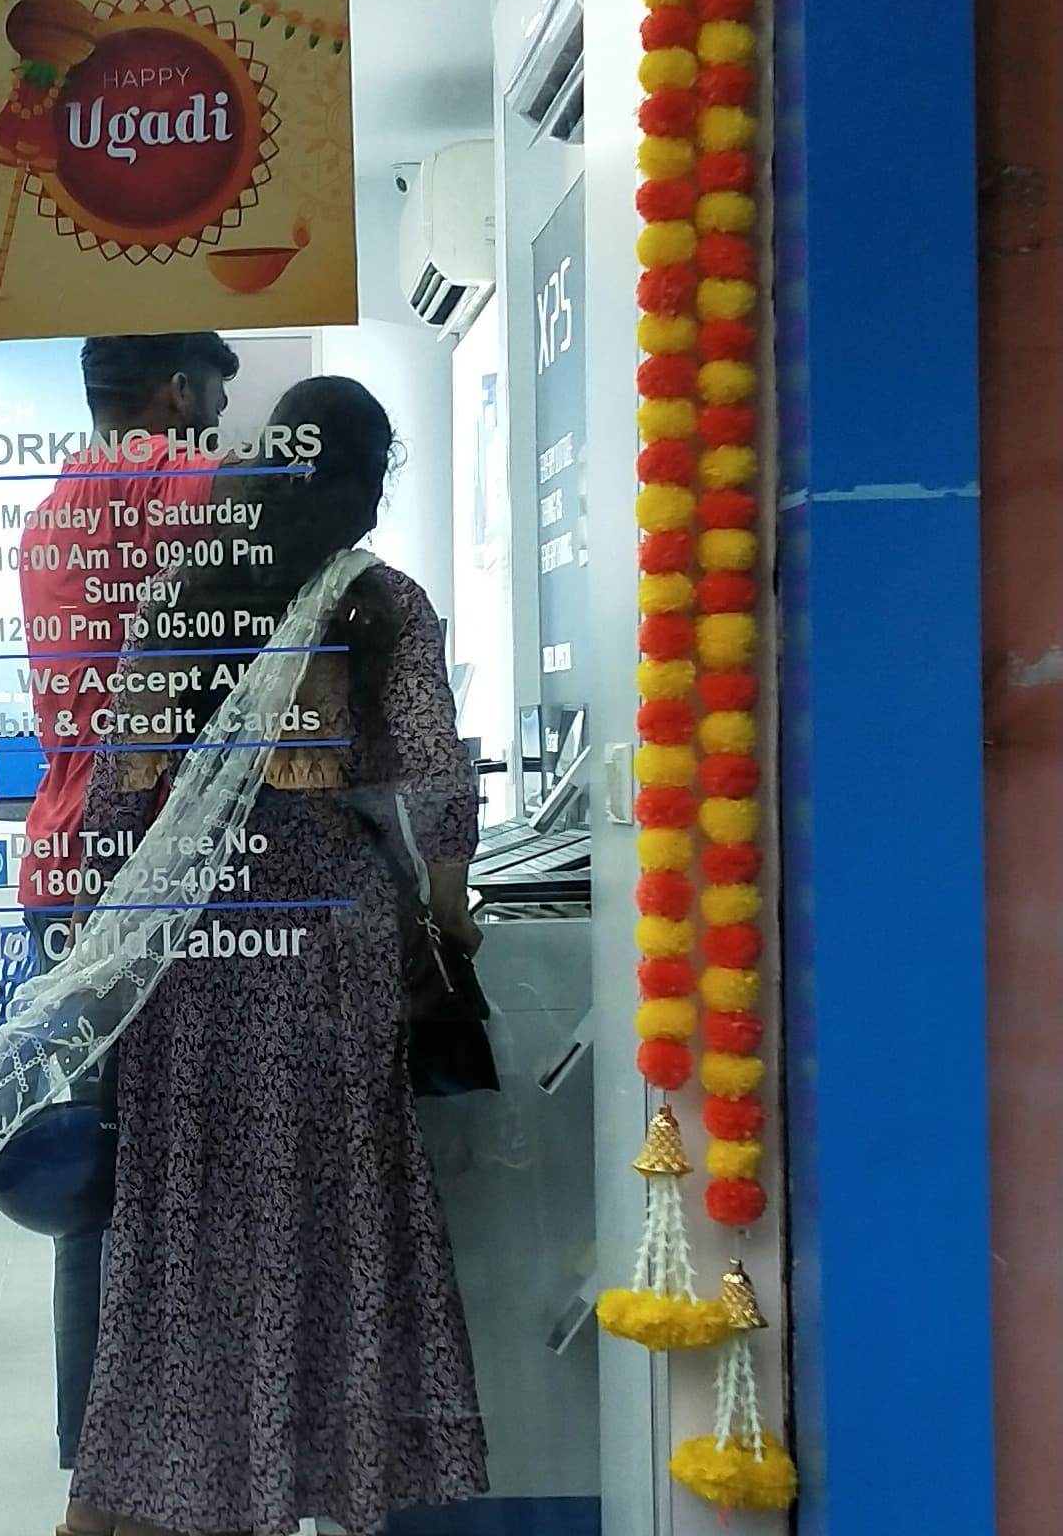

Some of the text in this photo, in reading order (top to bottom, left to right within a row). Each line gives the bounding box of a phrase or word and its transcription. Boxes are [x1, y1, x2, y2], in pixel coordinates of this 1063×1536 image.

[103, 66, 191, 89] HAPPY
[65, 91, 234, 165] Ugadi
[537, 257, 572, 375] XPS
[168, 423, 323, 462] HOURS
[2, 497, 263, 535] Monday To Saturday
[67, 543, 109, 569] Am
[117, 541, 147, 568] To
[155, 540, 224, 567] 09:00
[233, 538, 273, 566] Pm
[84, 577, 182, 608] Sunday
[70, 613, 111, 641] Pm
[119, 612, 148, 639] To
[156, 611, 226, 638] 05:00
[234, 610, 275, 637] Pm
[17, 668, 70, 695] We
[79, 666, 201, 698] Accept
[55, 710, 79, 736] &
[90, 706, 195, 736] Credit
[218, 705, 320, 733] Cards
[11, 832, 68, 859] Dell
[79, 831, 134, 857] Toll
[226, 829, 268, 854] No
[164, 920, 307, 959] Labour
